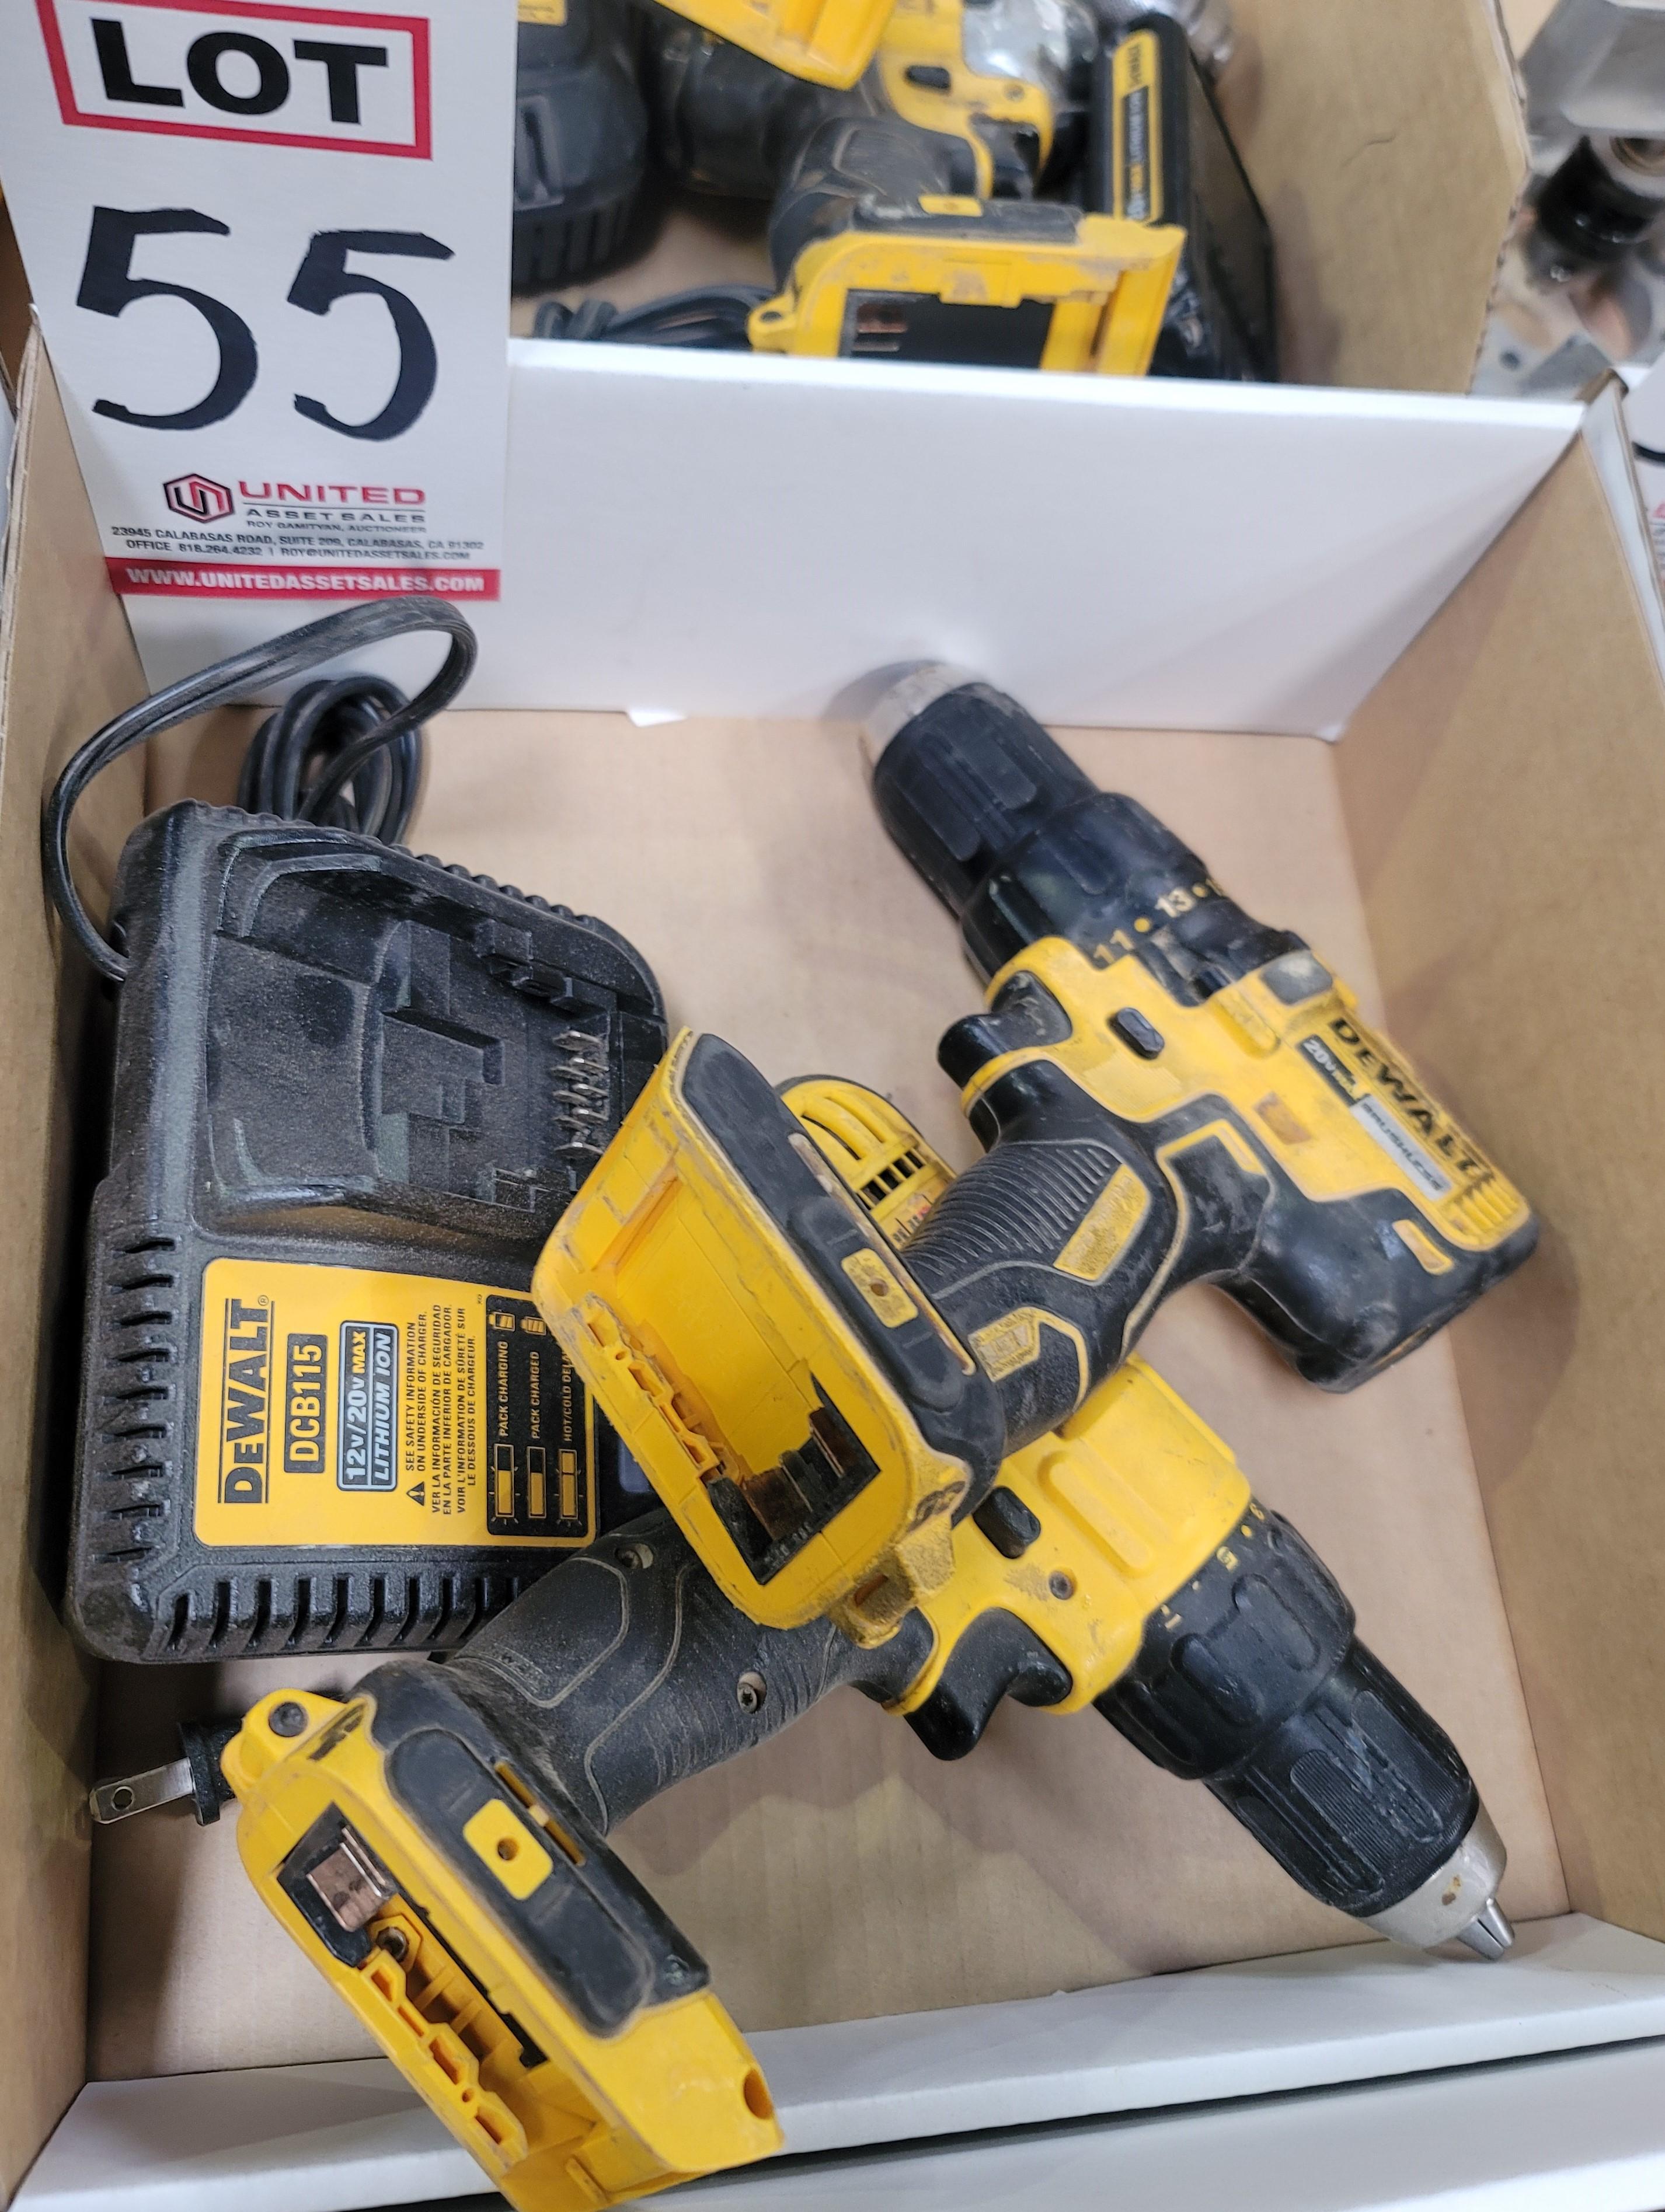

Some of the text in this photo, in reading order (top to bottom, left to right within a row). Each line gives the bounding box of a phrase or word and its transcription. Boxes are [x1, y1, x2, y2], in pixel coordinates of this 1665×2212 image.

[91, 18, 387, 124] LOT
[76, 205, 455, 442] 55
[112, 526, 151, 538] 23945
[155, 529, 234, 543] CALABASAS
[236, 533, 277, 546] ROAD,
[278, 536, 316, 546] SUITE
[428, 540, 445, 549] CA
[448, 540, 485, 549] 91302
[238, 481, 426, 504] UNITED
[247, 509, 426, 523] ASSET SALES
[247, 520, 273, 528] ROY
[349, 525, 427, 533] AUCTIONEER
[126, 539, 172, 552] OFFICE
[178, 543, 263, 556] 818.264.4232
[281, 546, 471, 560] ROY@UNITEDASSETSALES.COM
[126, 568, 485, 591] WWW.UNITEDASSETSALES.COM
[1155, 888, 1194, 917] 13
[1329, 1018, 1486, 1176] DEWALT
[1362, 1103, 1444, 1191] BRUSHLESS
[224, 1299, 269, 1503] DEWALT
[352, 1331, 367, 1374] MAX
[406, 1322, 416, 1471] SEE SAFETY INFORMATION
[417, 1311, 428, 1471] ON UNDERSIDE OF CHARGER.
[498, 1340, 509, 1437] PACK CHARGING
[529, 1351, 541, 1439] PACK CHARGED
[561, 1350, 573, 1442] HOT/COLD DELA
[290, 1344, 322, 1462] DCB115
[374, 1332, 392, 1481] LITHIUM ION
[430, 1304, 442, 1513] VER LA INFORMACIÓN DE SEGURIDAD
[443, 1304, 452, 1515] EN LA PARTE INFERIOR DE CARGADOR.
[455, 1308, 466, 1513] VOIR L'INFORMATION DE SÛRETÉ SUR
[468, 1335, 476, 1486] LE DESSOUS DE CHARGEUR.
[1215, 1546, 1239, 1571] 5
